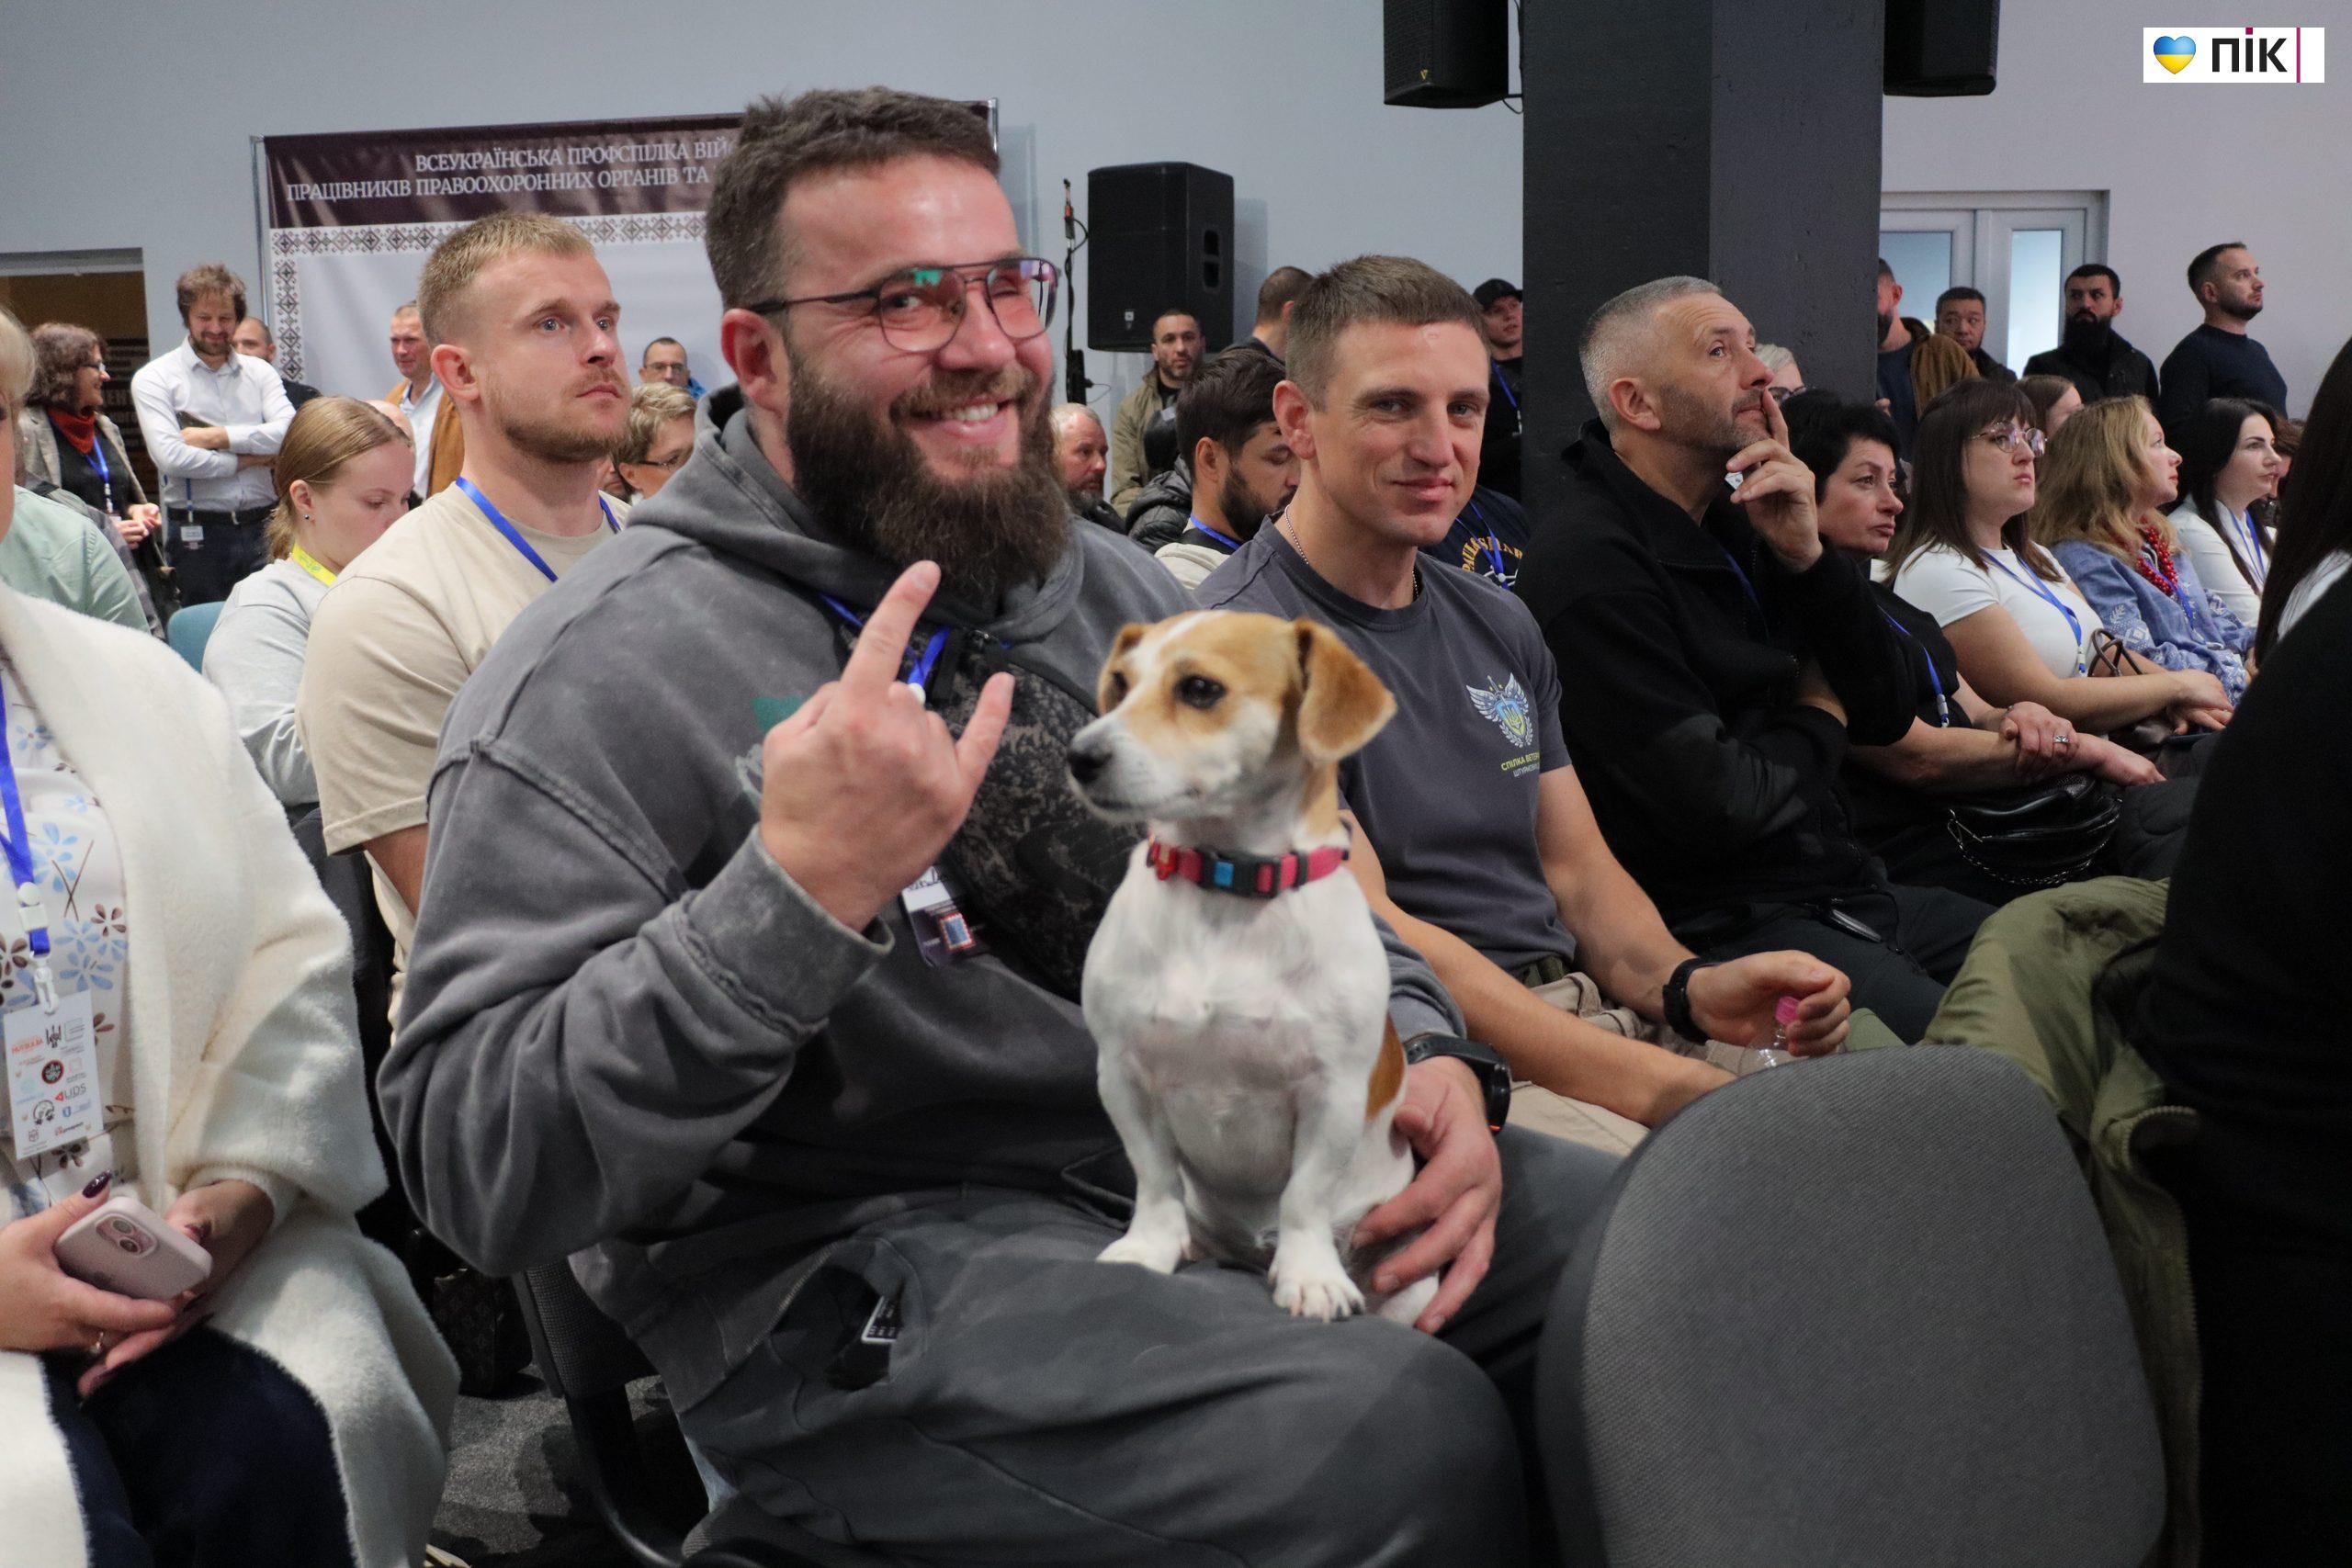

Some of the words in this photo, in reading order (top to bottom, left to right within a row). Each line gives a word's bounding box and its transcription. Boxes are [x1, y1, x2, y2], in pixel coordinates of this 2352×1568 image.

[415, 147, 562, 173] ВСЕУКРАЇНСЬКА
[567, 142, 688, 165] ПРОФСПІЛКА
[287, 179, 412, 202] ПРАЦІВНИКІВ
[415, 172, 595, 196] ПРАВООХОРОННИХ
[597, 168, 679, 189] ОРГАНІВ
[683, 166, 709, 184] ТА
[1500, 756, 1525, 771] СПІЛКА
